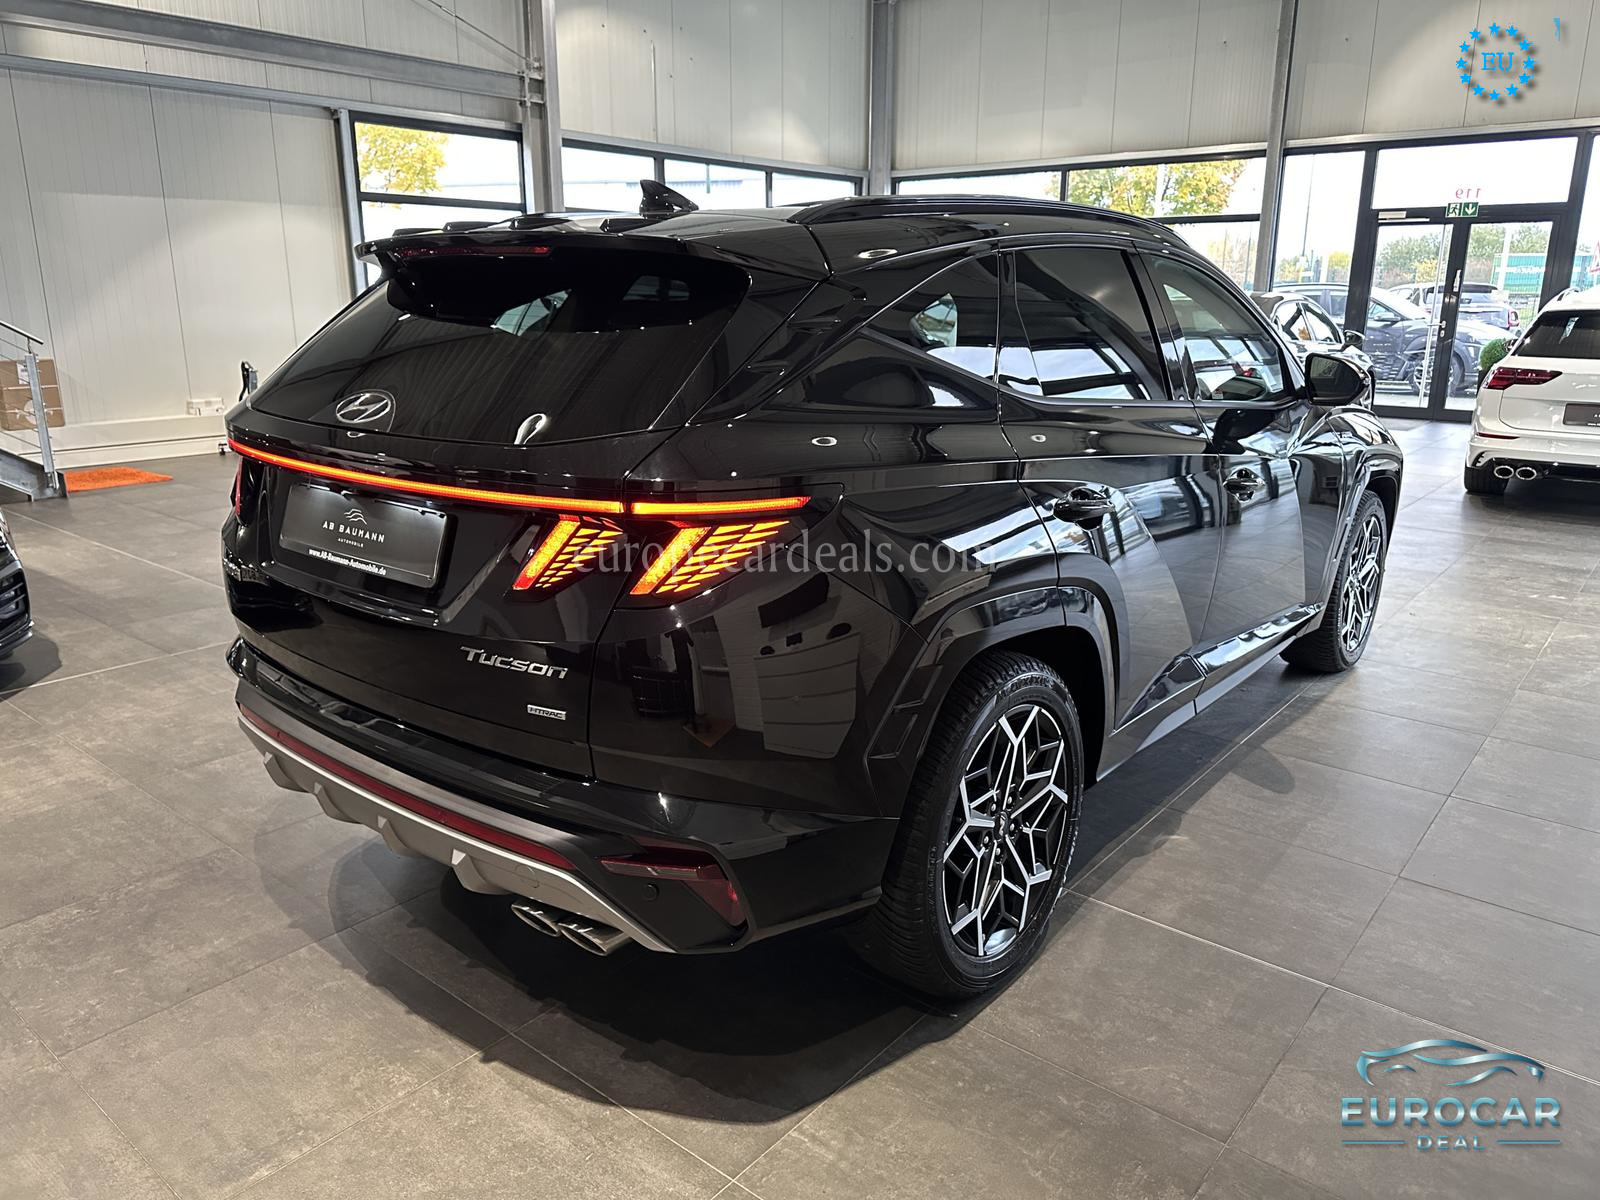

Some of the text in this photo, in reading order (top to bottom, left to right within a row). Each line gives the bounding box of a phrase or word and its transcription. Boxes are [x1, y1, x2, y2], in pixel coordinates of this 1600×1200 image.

[322, 520, 386, 543] AB BAUMANN
[337, 538, 364, 548] AUTOMOBILE
